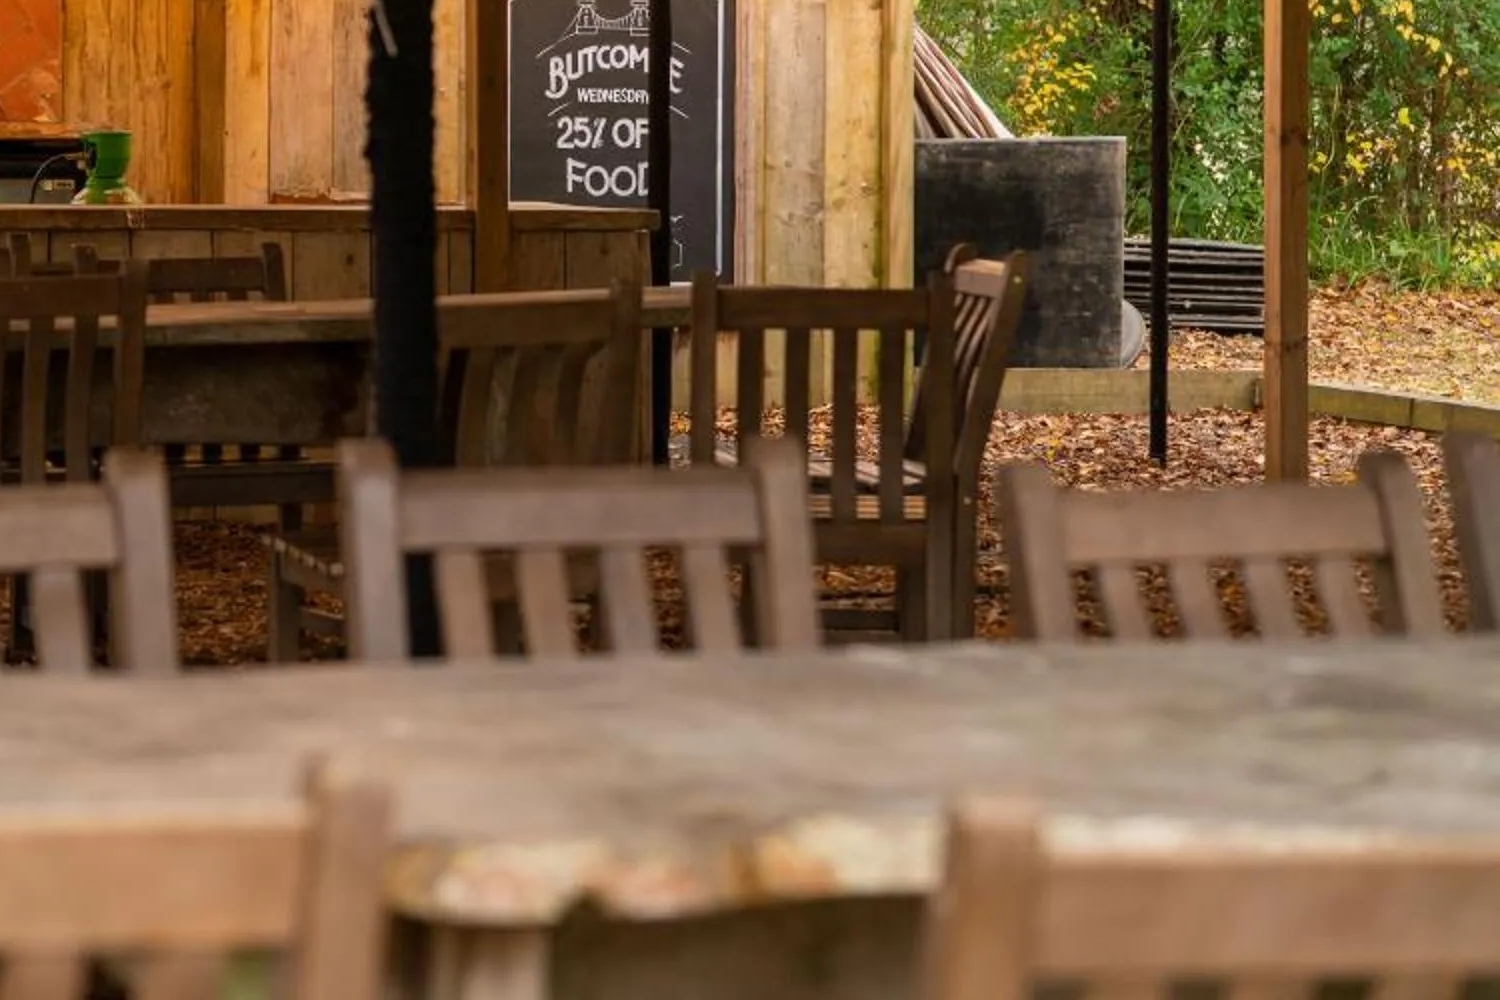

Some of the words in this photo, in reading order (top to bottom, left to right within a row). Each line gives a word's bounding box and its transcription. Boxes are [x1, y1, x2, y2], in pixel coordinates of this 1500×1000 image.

[544, 44, 685, 100] BUTCOME
[556, 116, 607, 149] 25%
[612, 117, 649, 149] OF
